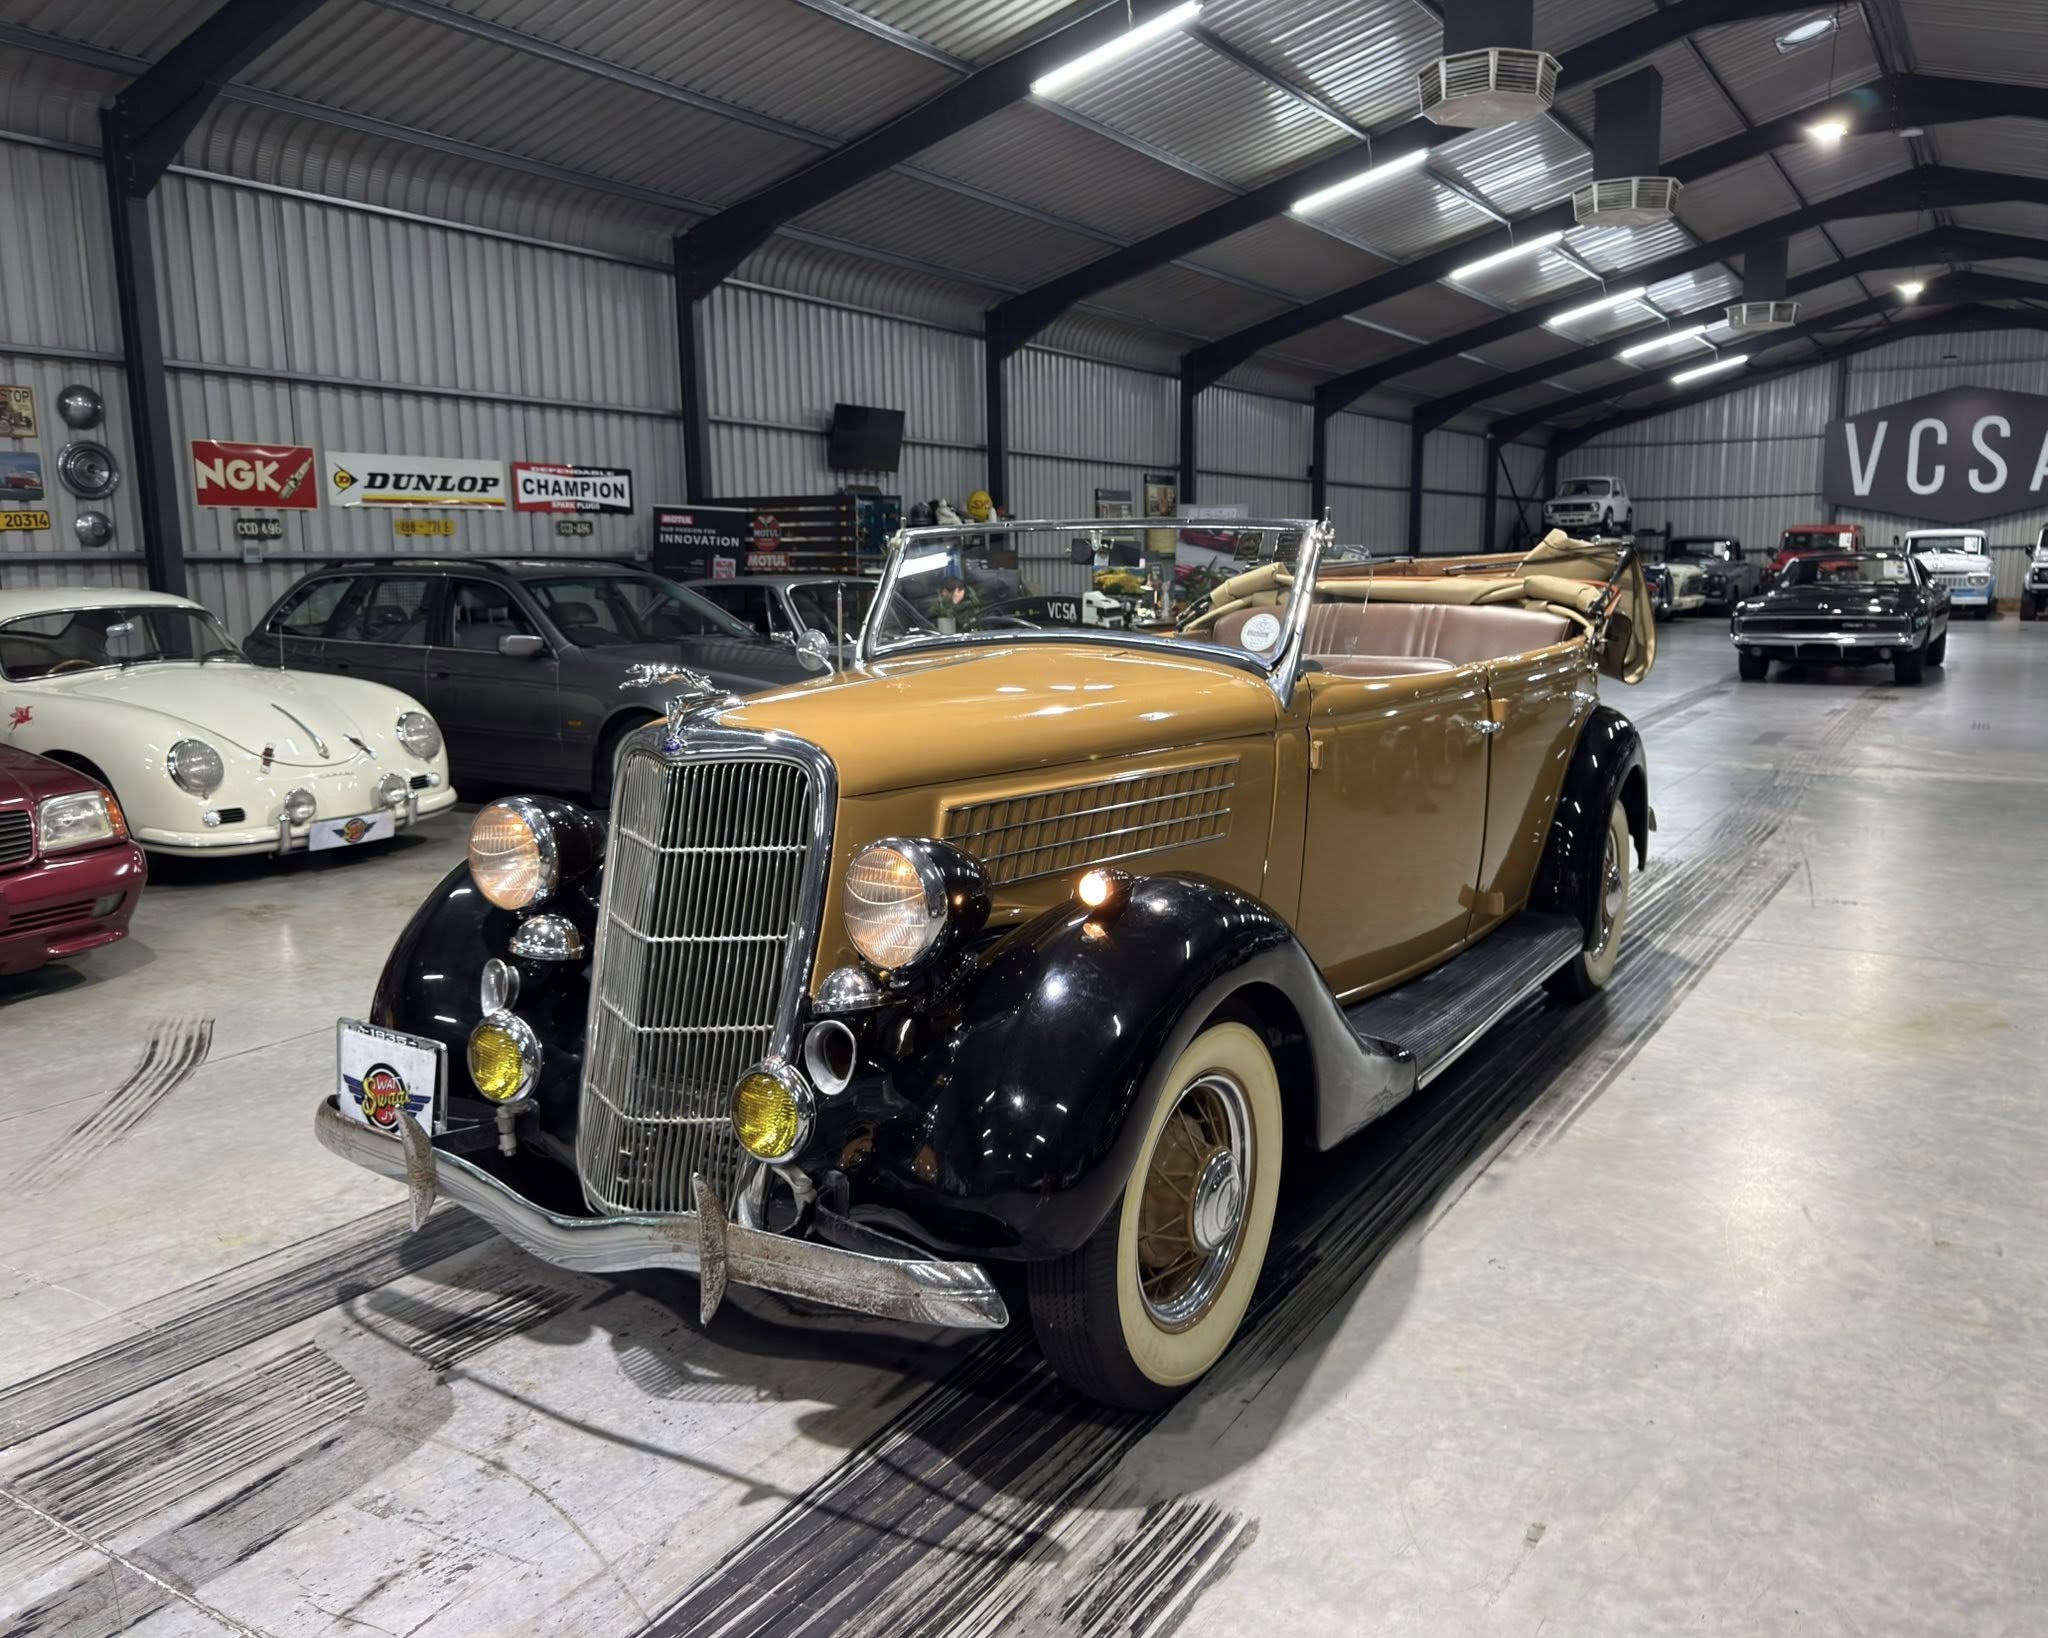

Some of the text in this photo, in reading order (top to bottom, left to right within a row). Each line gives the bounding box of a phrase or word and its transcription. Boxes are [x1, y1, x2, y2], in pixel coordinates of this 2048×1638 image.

[195, 458, 281, 492] NGK
[530, 466, 616, 476] DEPENDABLE
[364, 472, 499, 493] DUNLOP
[522, 478, 625, 499] CHAMPION
[552, 501, 575, 509] SPARK
[4, 513, 48, 528] 20314
[659, 533, 740, 547] INNOVATION
[747, 554, 787, 567] MOTUL
[1047, 601, 1078, 621] VCSA
